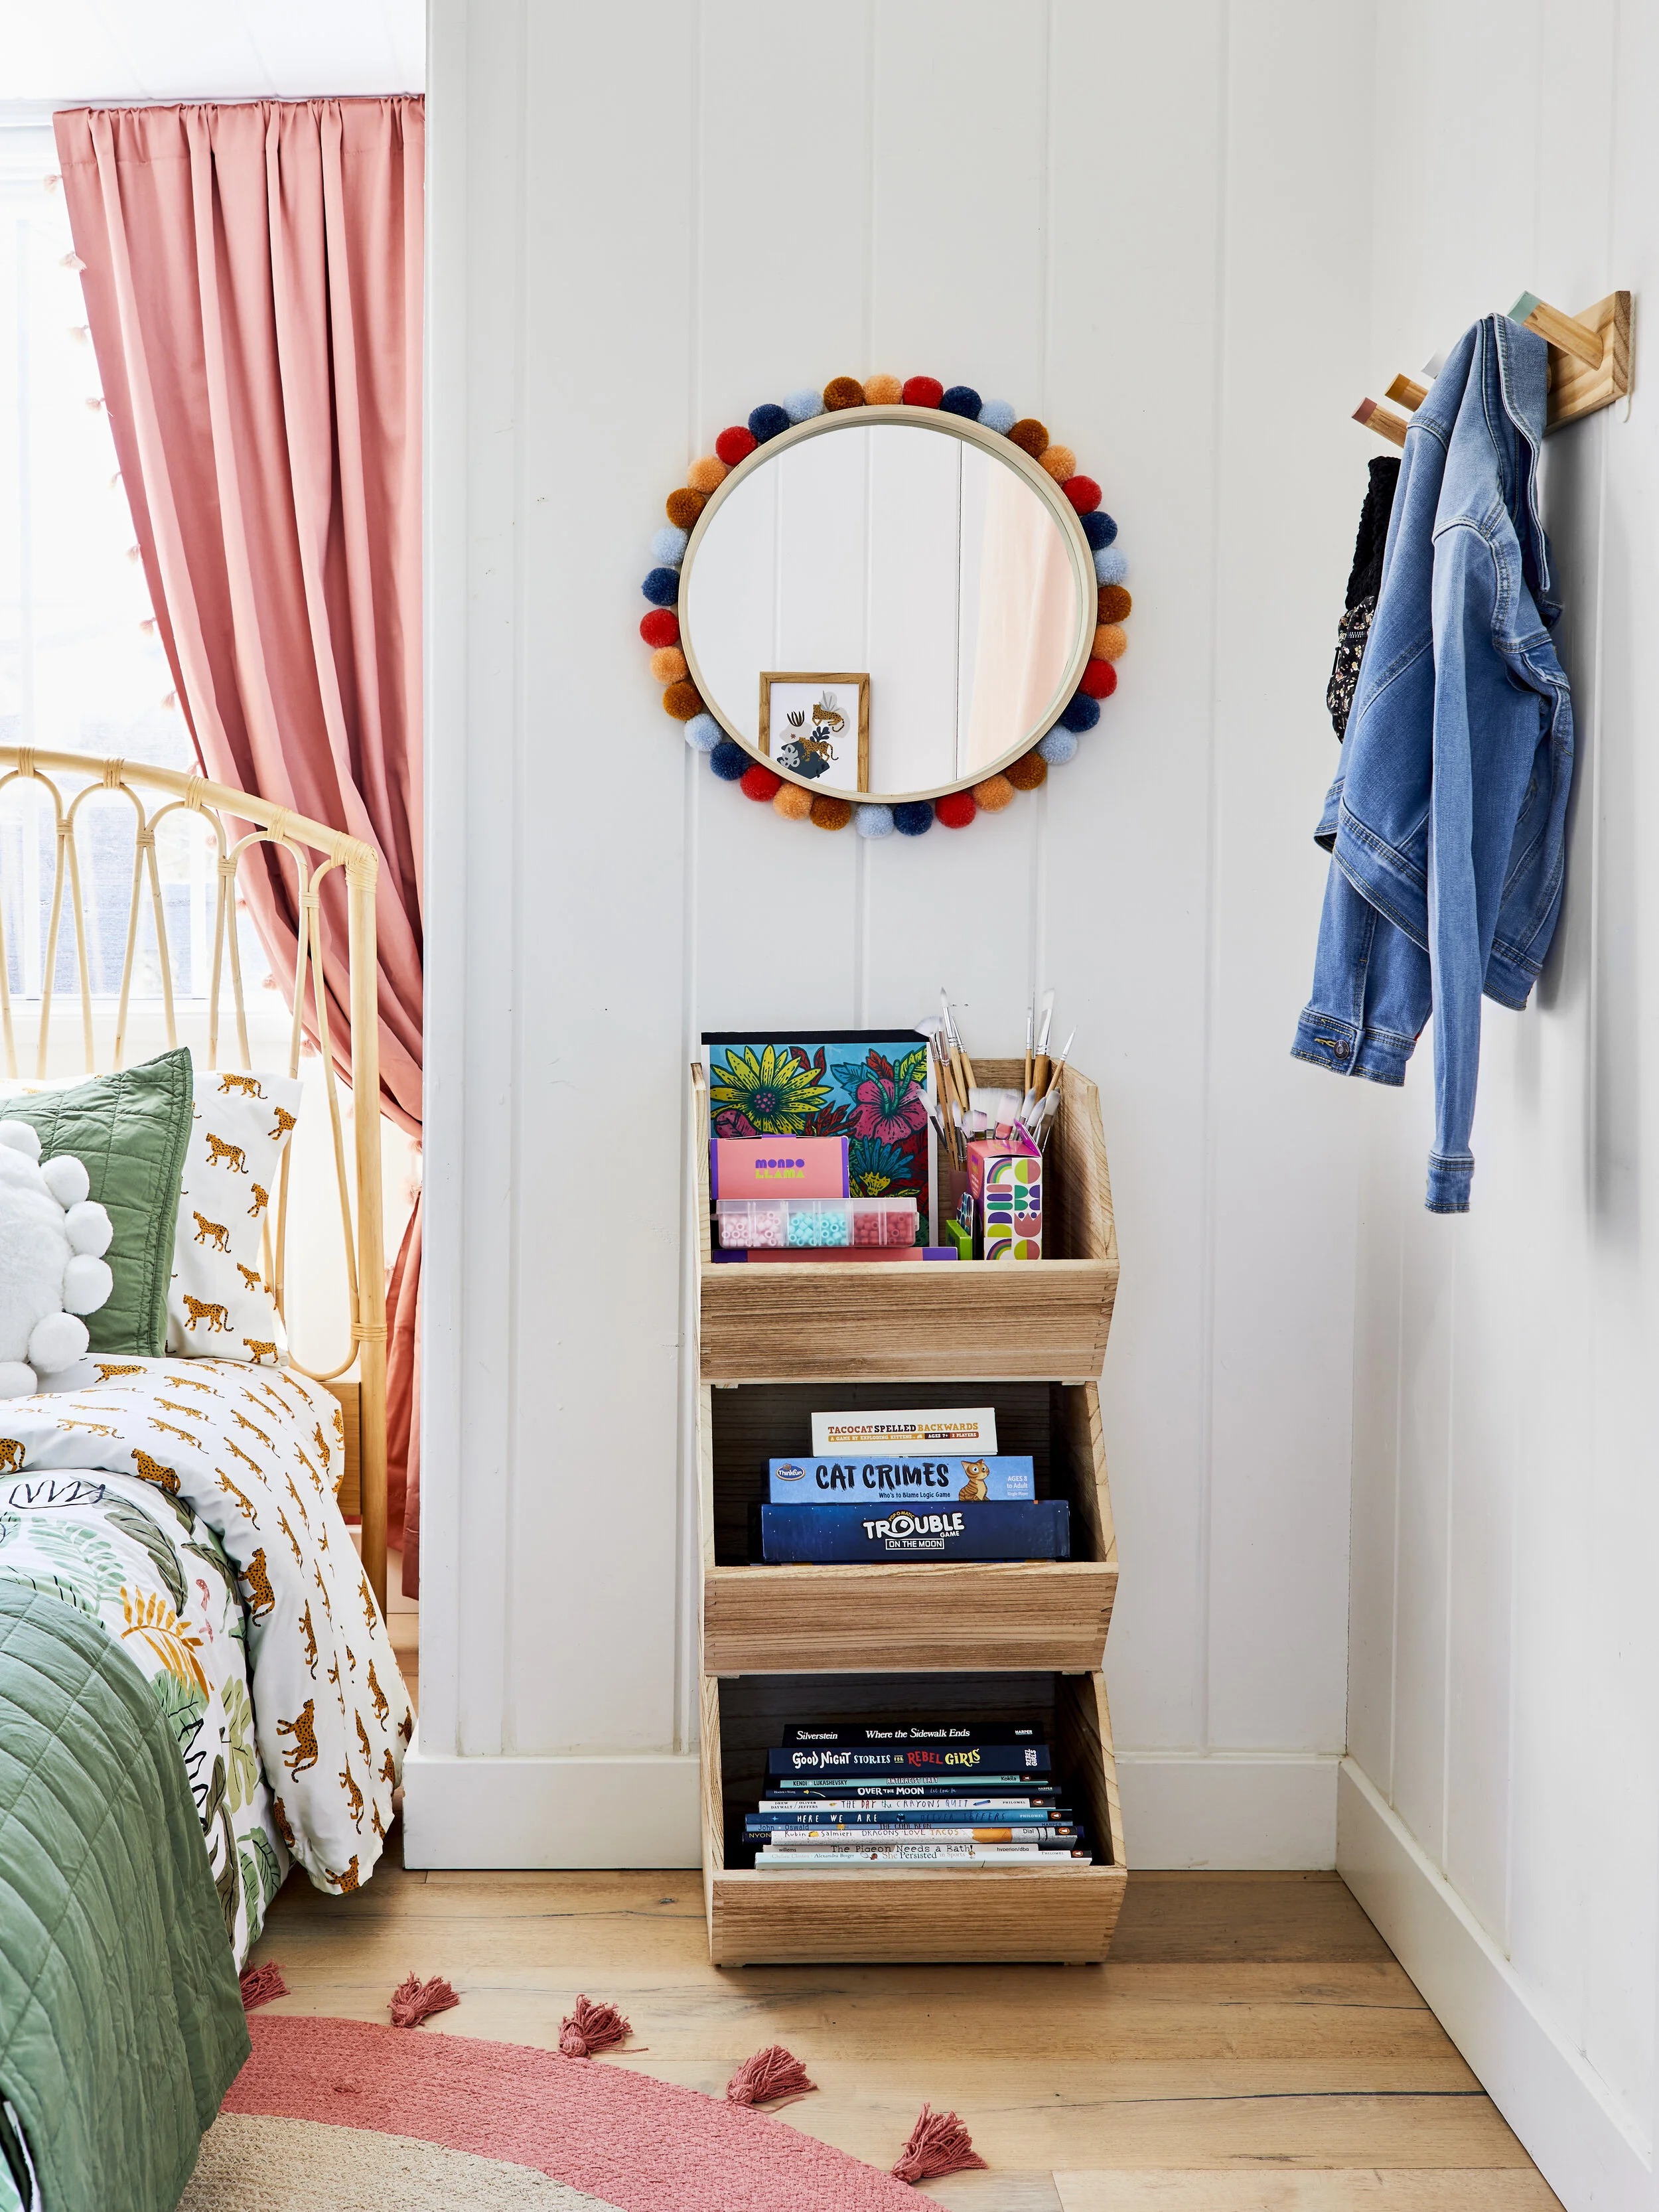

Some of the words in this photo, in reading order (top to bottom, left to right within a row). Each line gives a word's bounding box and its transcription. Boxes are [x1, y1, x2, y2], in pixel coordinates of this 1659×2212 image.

[755, 1159, 805, 1169] MONDO
[755, 1169, 805, 1179] LLAMA
[828, 1426, 873, 1434] TACOCAT
[874, 1424, 916, 1433] SPELLED
[917, 1422, 979, 1432] BACKWARDS
[816, 1463, 857, 1491] CAT
[862, 1462, 950, 1491] CRIMES
[863, 1512, 965, 1539] TROUBLE
[796, 1730, 838, 1739] Silverstein
[865, 1730, 893, 1738] Where
[895, 1730, 908, 1738] the
[909, 1728, 947, 1737] Sidewalk
[948, 1728, 970, 1737] Ends
[853, 1754, 891, 1764] STORIES
[906, 1751, 944, 1767] REBEL
[857, 1787, 883, 1796] OVER
[896, 1787, 924, 1795] MOON
[841, 1800, 856, 1808] THE
[861, 1799, 877, 1809] DAY
[881, 1800, 893, 1808] the
[897, 1799, 940, 1808] CRAYONS
[945, 1799, 968, 1808] QUIT
[797, 1814, 820, 1823] HERE
[830, 1814, 843, 1823] WE
[857, 1814, 877, 1822] ARE
[920, 1813, 954, 1822] OLIVER
[964, 1812, 1005, 1822] JEFFERS
